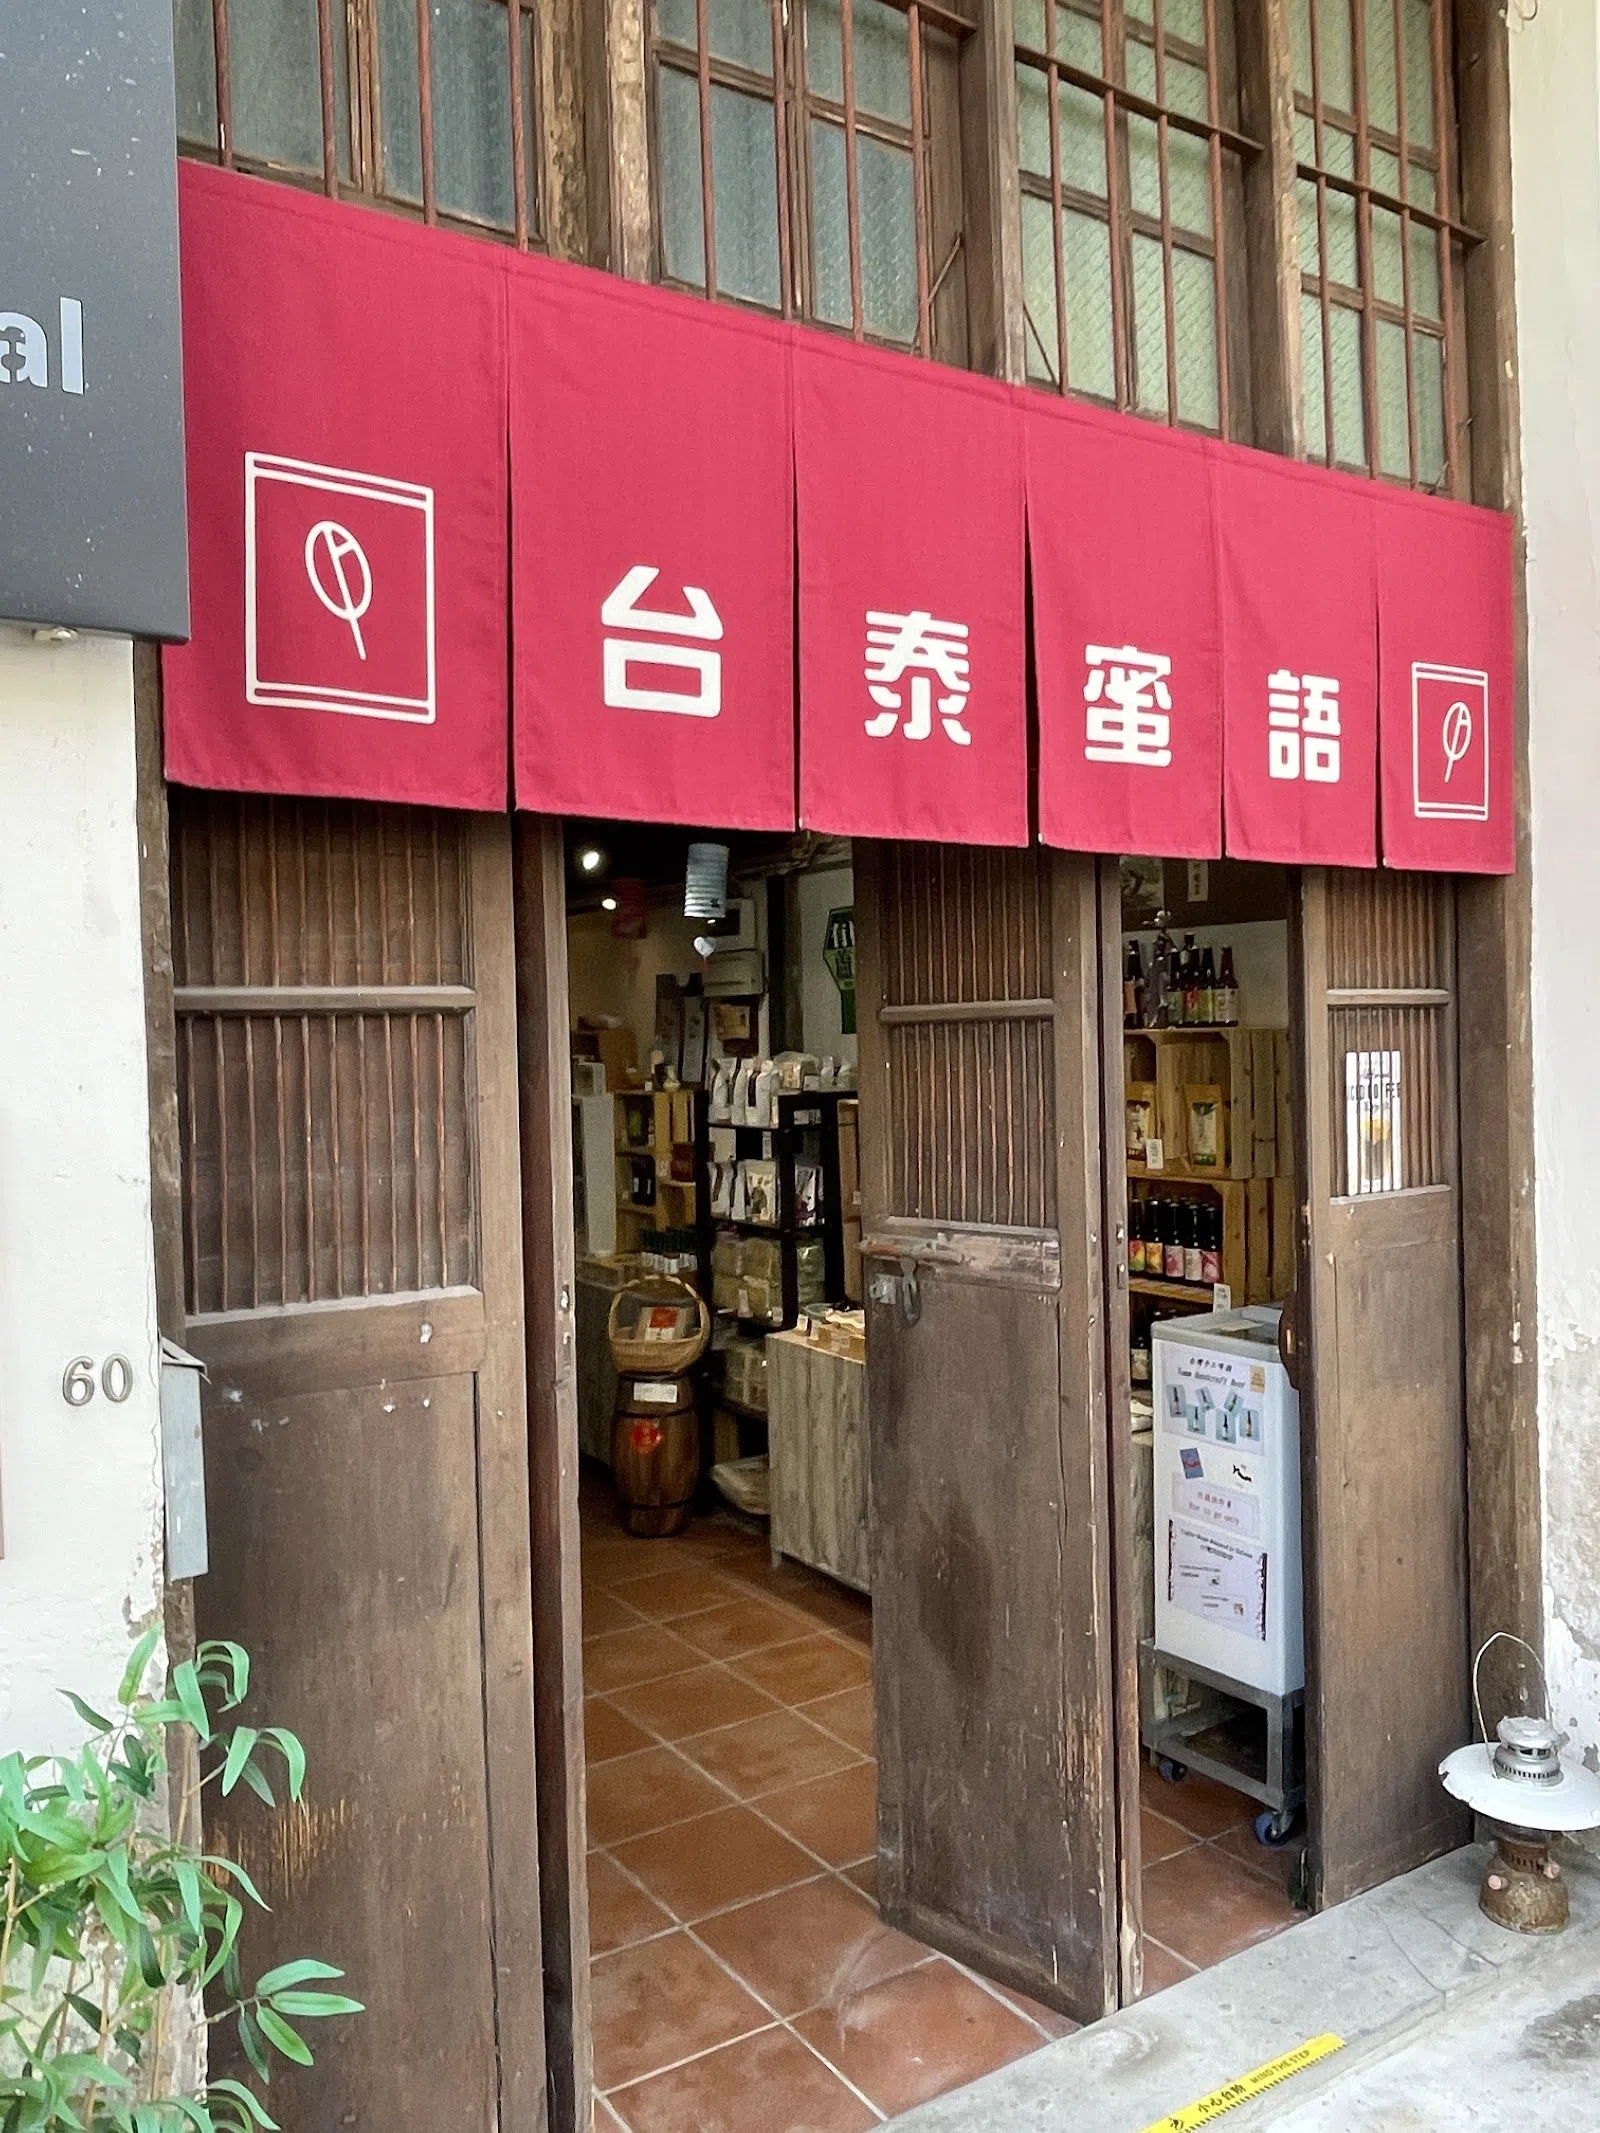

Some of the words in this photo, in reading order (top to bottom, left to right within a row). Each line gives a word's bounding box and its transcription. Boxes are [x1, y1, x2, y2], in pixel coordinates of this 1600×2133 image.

[601, 563, 1343, 785] 台泰蜜語
[62, 1353, 134, 1407] 60
[1250, 2069, 1274, 2084] MIND
[1272, 2059, 1291, 2073] THE
[1289, 2049, 1310, 2066] STEP
